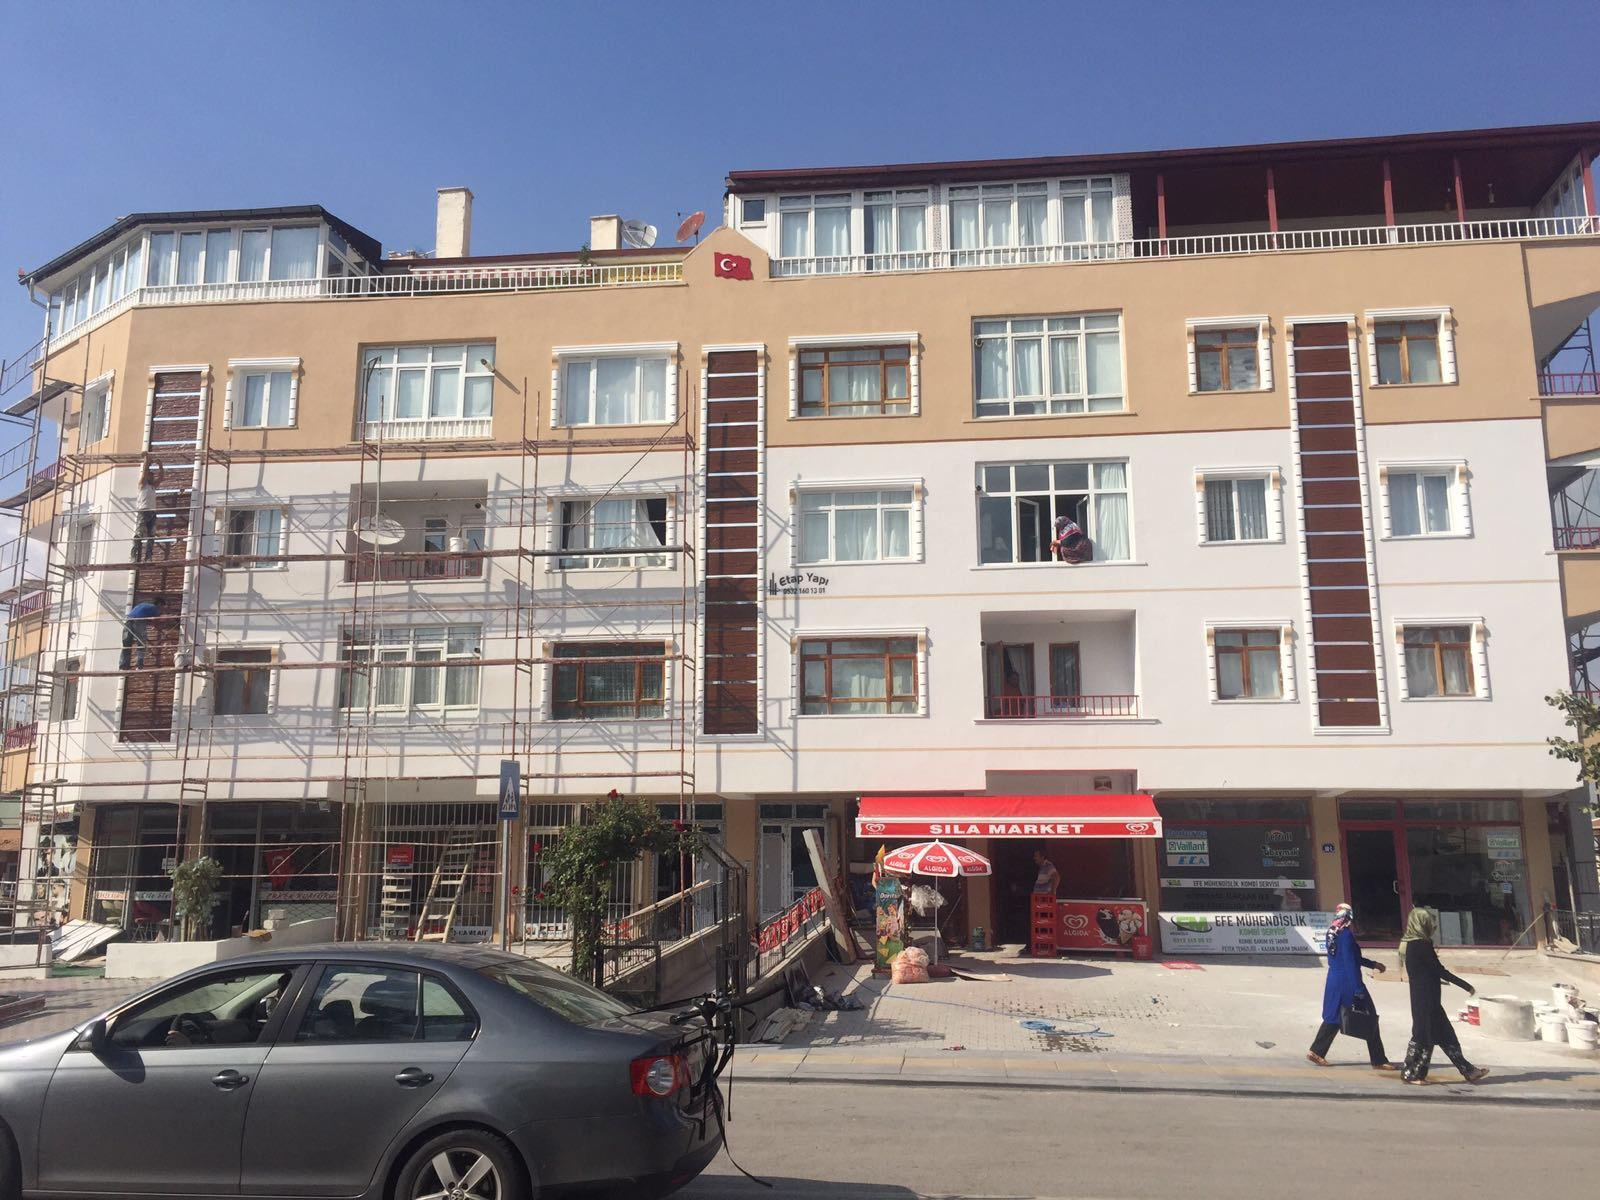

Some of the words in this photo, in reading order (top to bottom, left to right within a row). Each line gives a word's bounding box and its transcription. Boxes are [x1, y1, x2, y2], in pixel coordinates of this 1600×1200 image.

[779, 575, 804, 586] Etap
[929, 824, 981, 835] SILA
[989, 824, 1085, 834] MARKET
[1177, 841, 1206, 851] Vaillant
[1215, 915, 1233, 927] EFE
[1236, 914, 1307, 927] MÜHENDİSLİK
